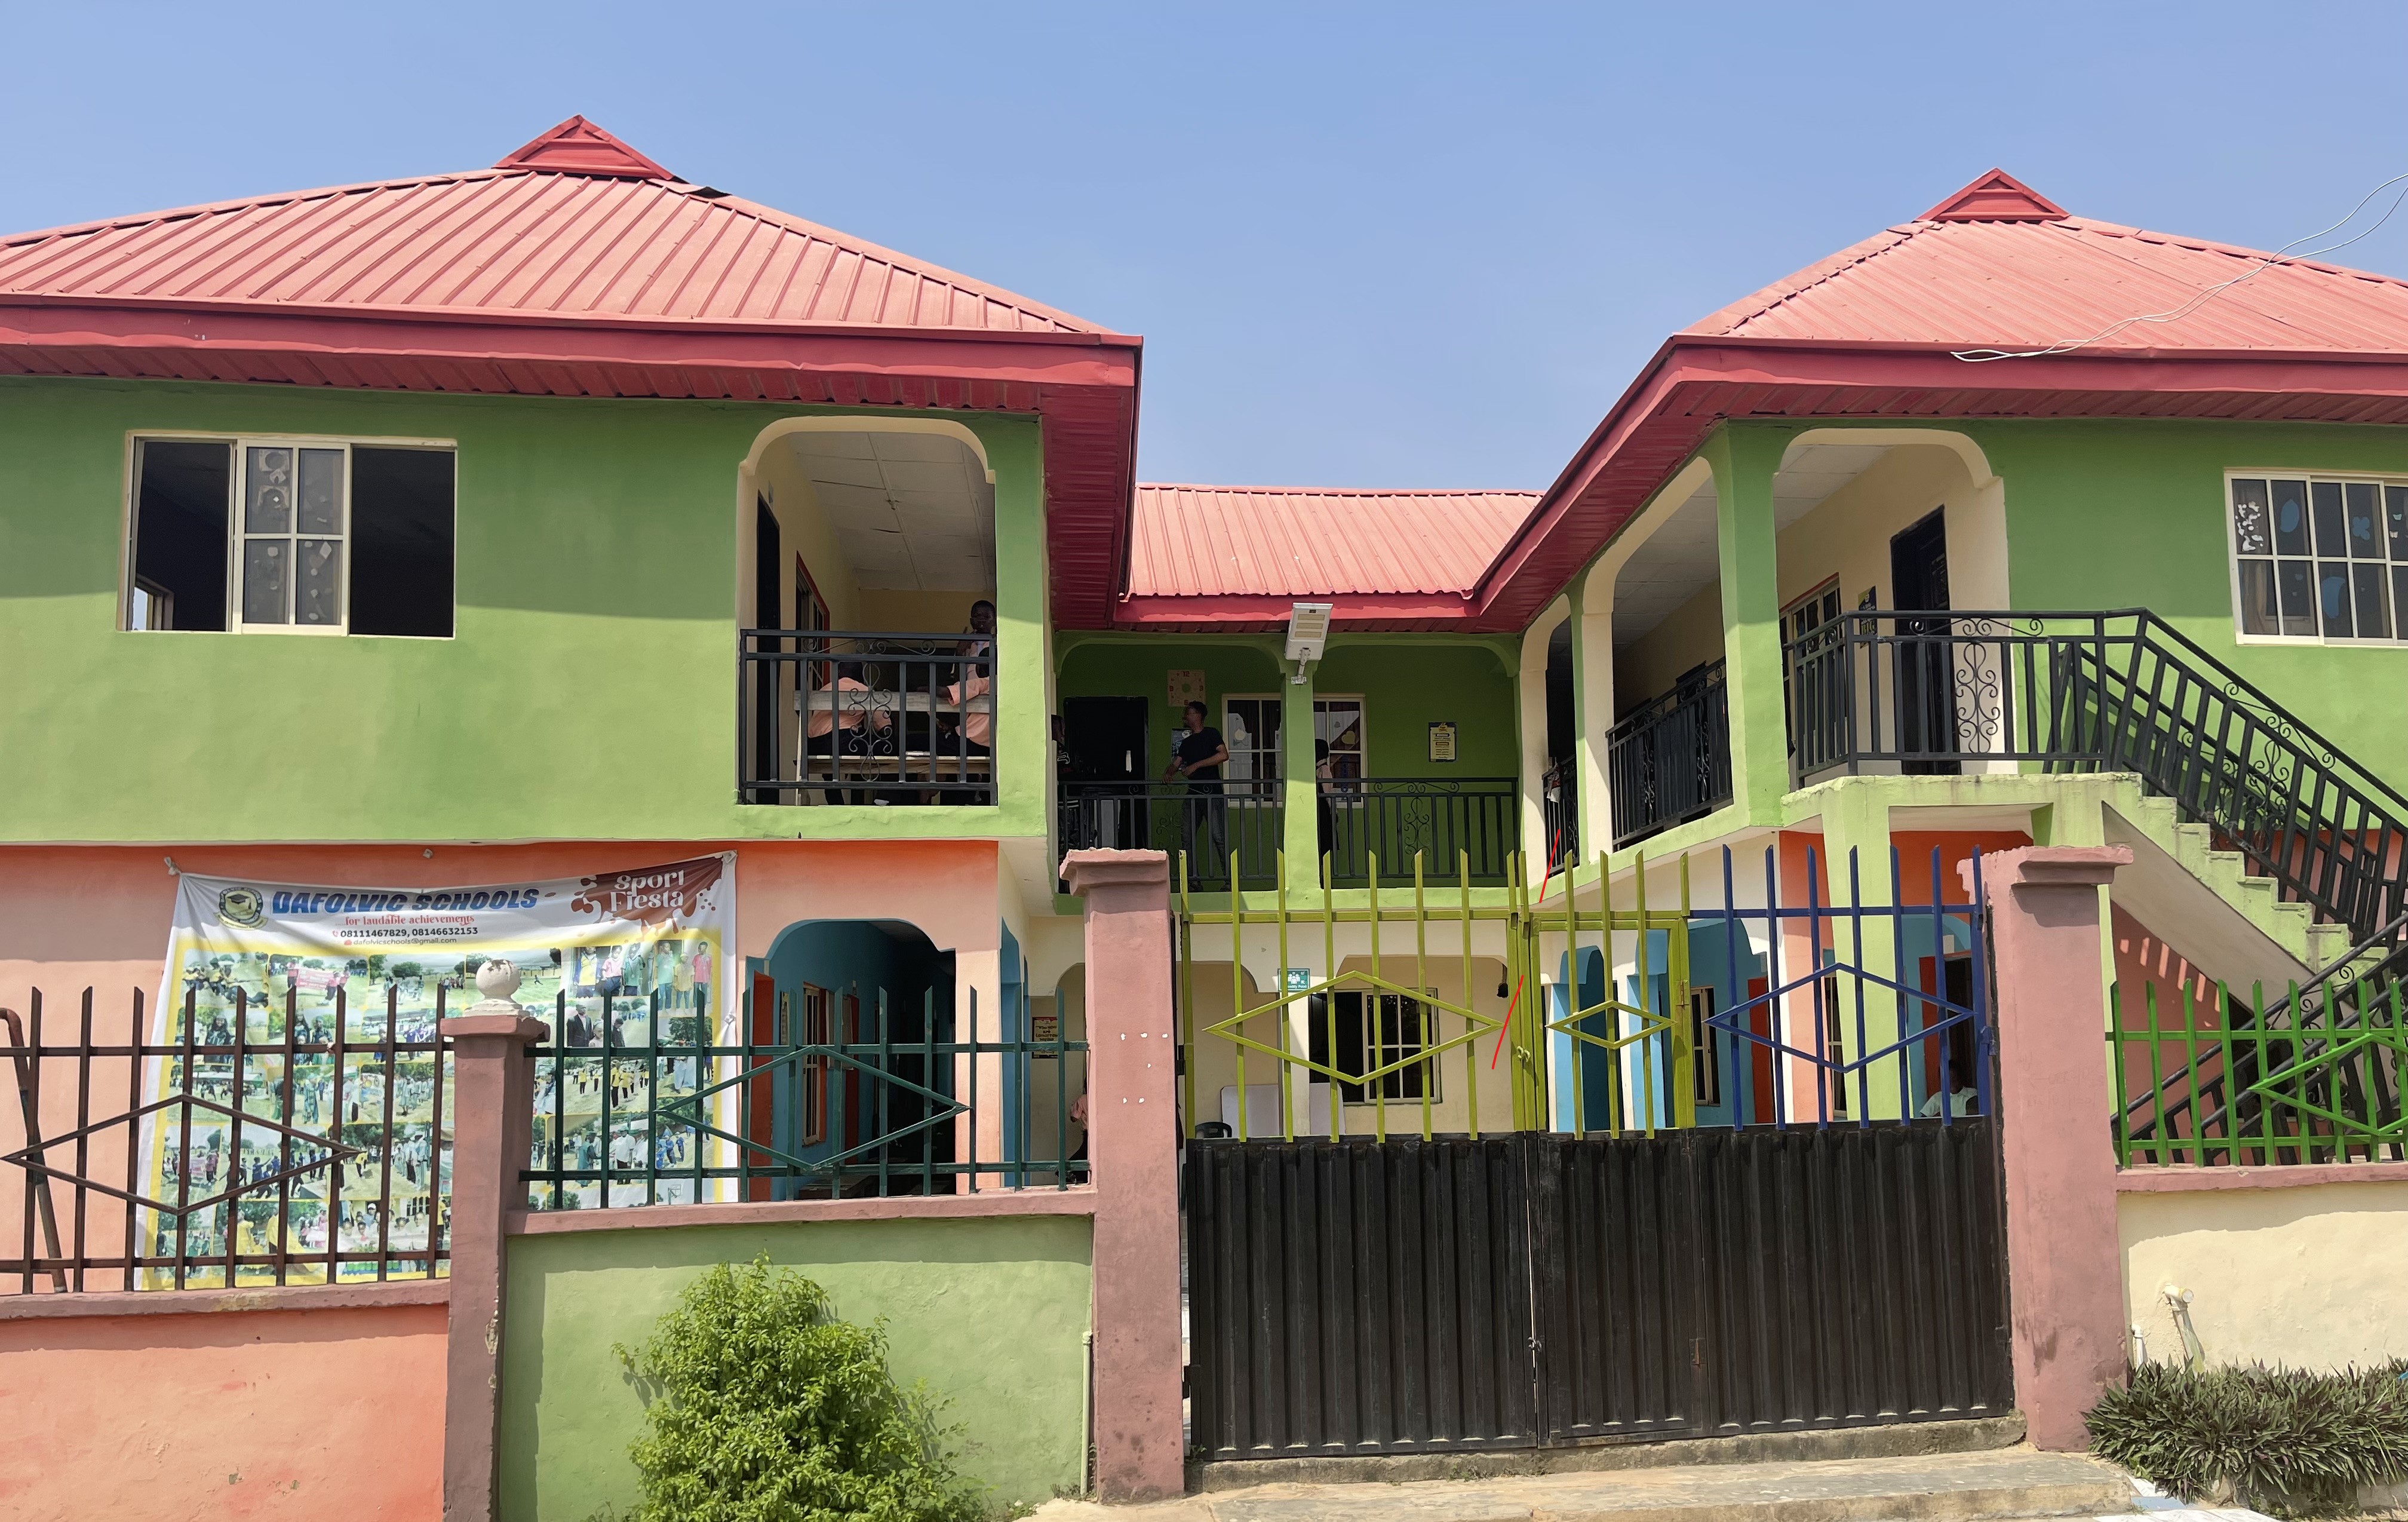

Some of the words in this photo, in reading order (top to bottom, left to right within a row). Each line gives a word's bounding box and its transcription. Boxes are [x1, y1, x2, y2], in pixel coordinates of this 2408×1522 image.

[614, 870, 685, 897] Sport
[272, 891, 408, 914] DAFOLVIC
[411, 888, 539, 911] SCHOOLS
[610, 891, 684, 912] Fiesta
[363, 914, 406, 925] laudable
[409, 915, 475, 926] achievements
[340, 929, 410, 938] 08111467829,
[411, 927, 478, 936] 08146632153
